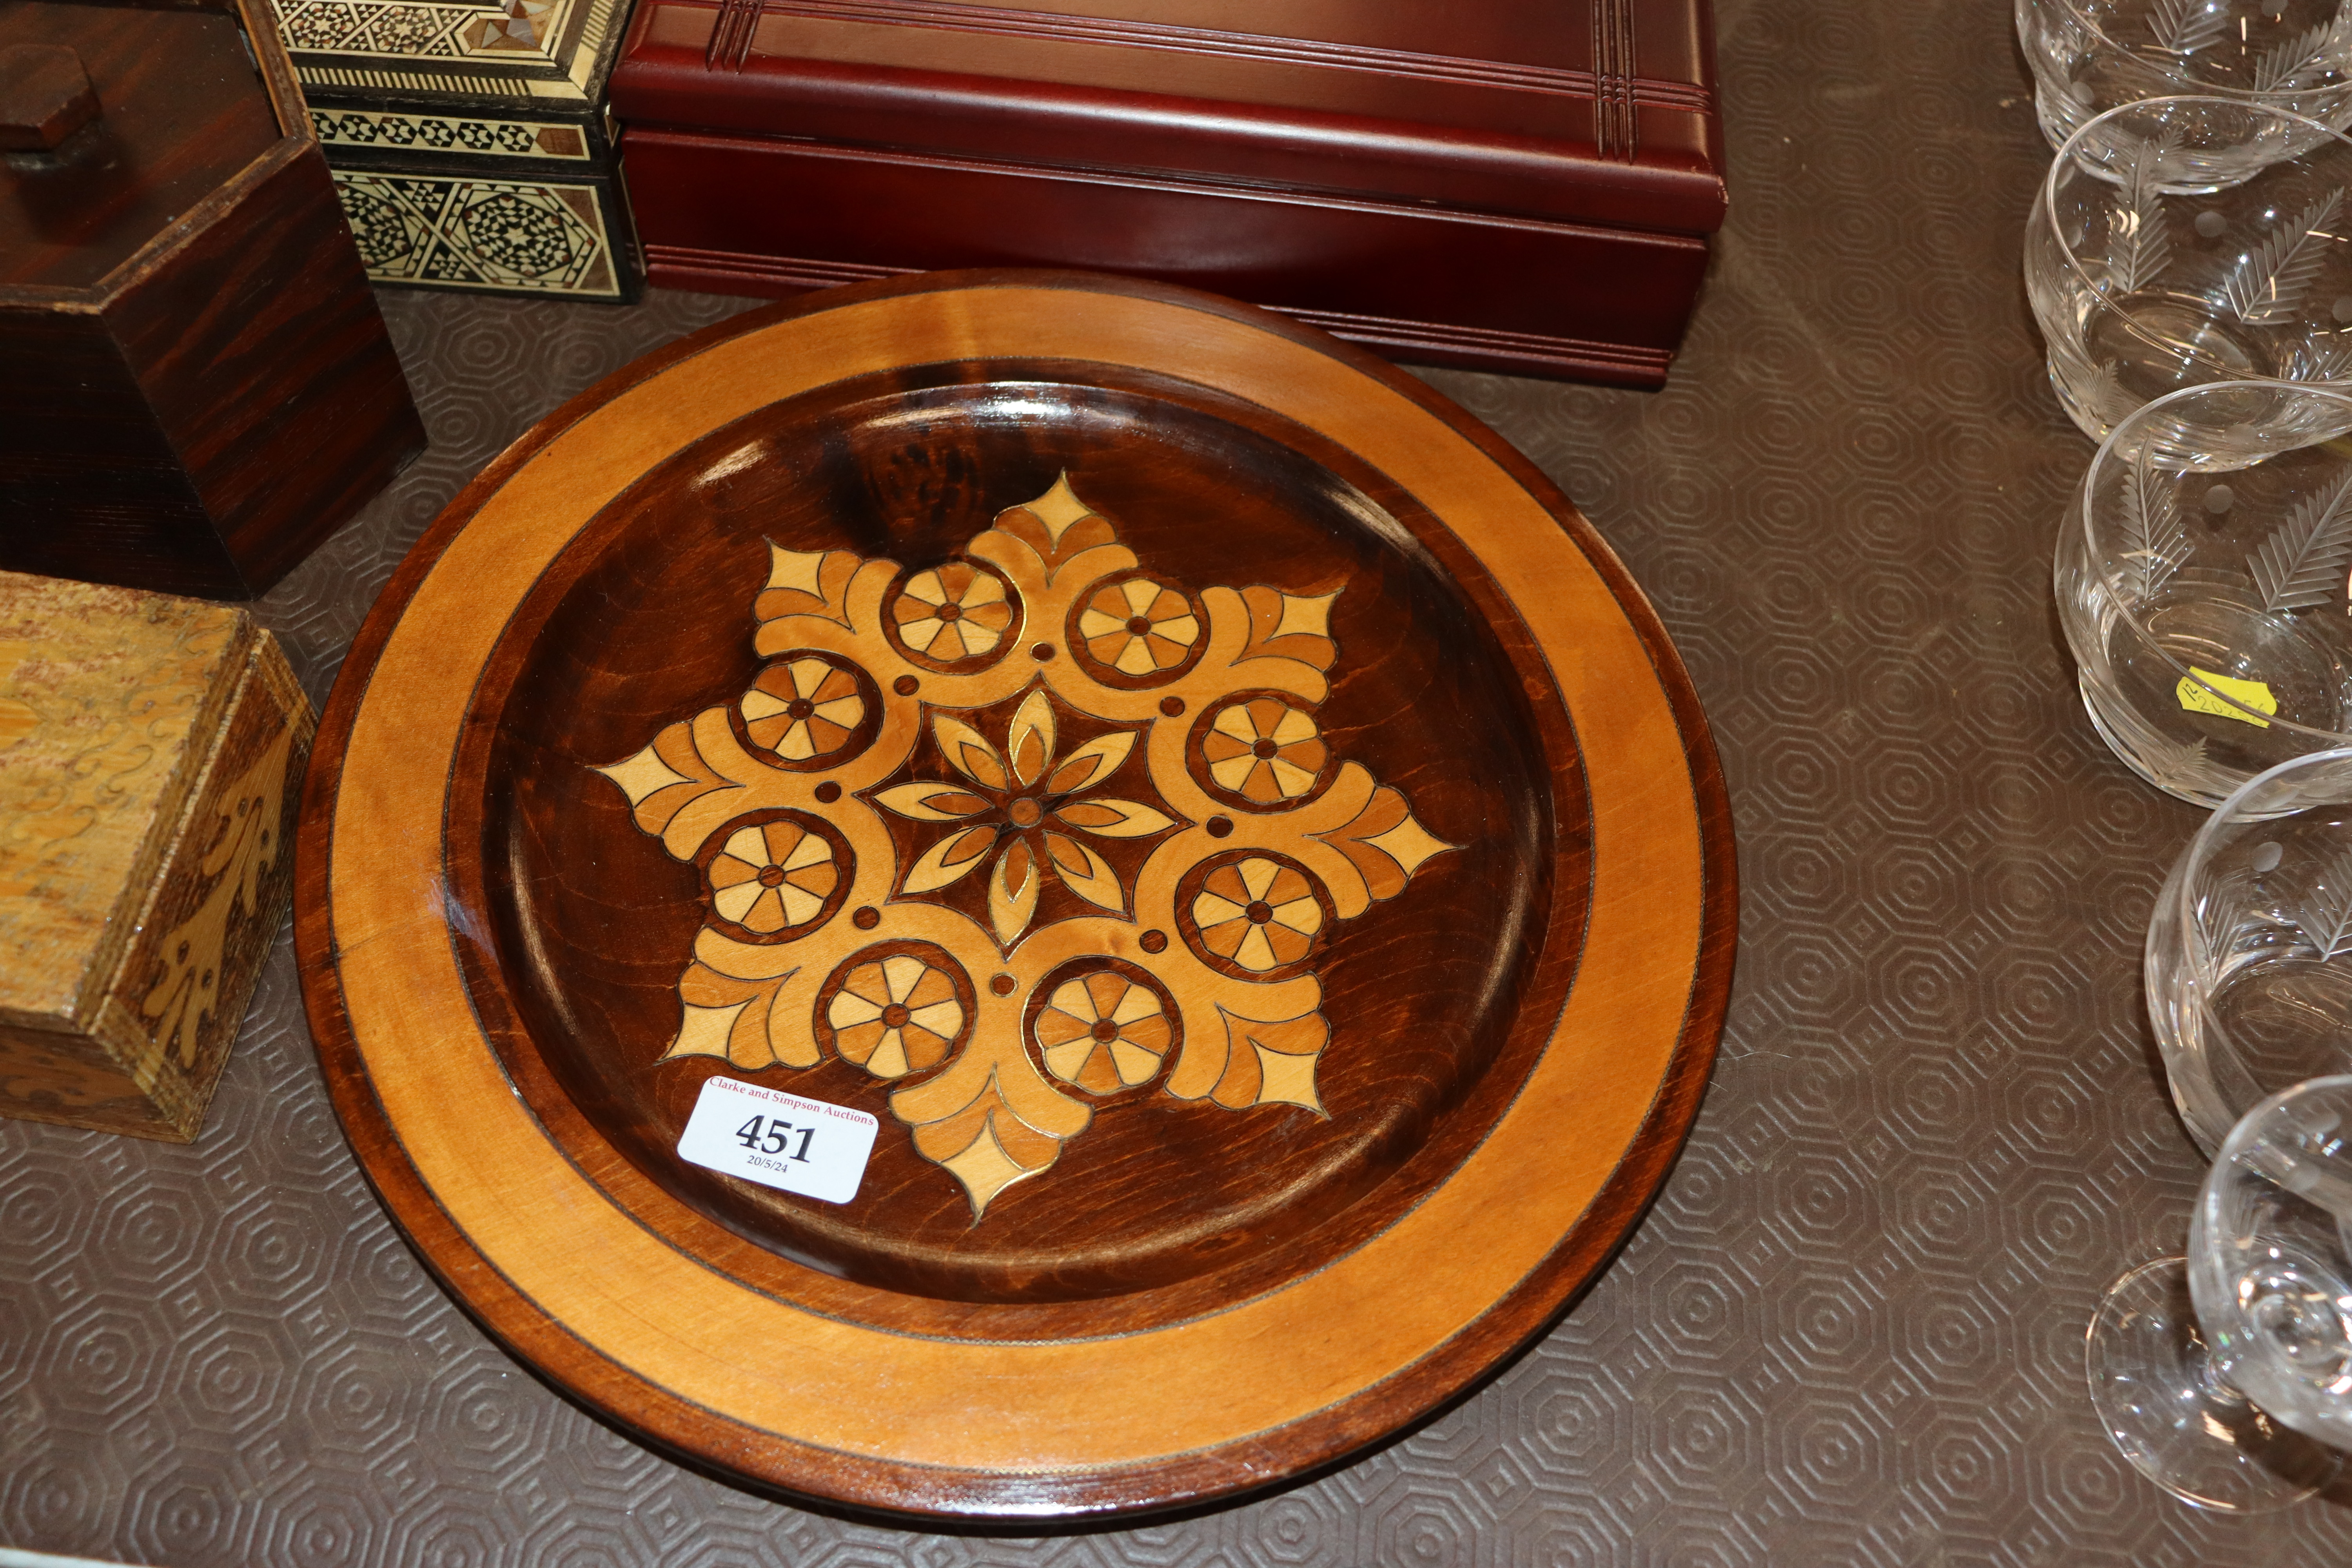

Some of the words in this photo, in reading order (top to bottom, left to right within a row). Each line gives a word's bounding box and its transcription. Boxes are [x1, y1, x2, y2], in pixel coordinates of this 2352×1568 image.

[710, 1077, 746, 1093] Clarke
[748, 1089, 769, 1100] and
[772, 1093, 820, 1112] Simpson
[823, 1106, 874, 1125] Auctions
[736, 1115, 815, 1163] 451
[747, 1155, 788, 1173] 20/5/24
